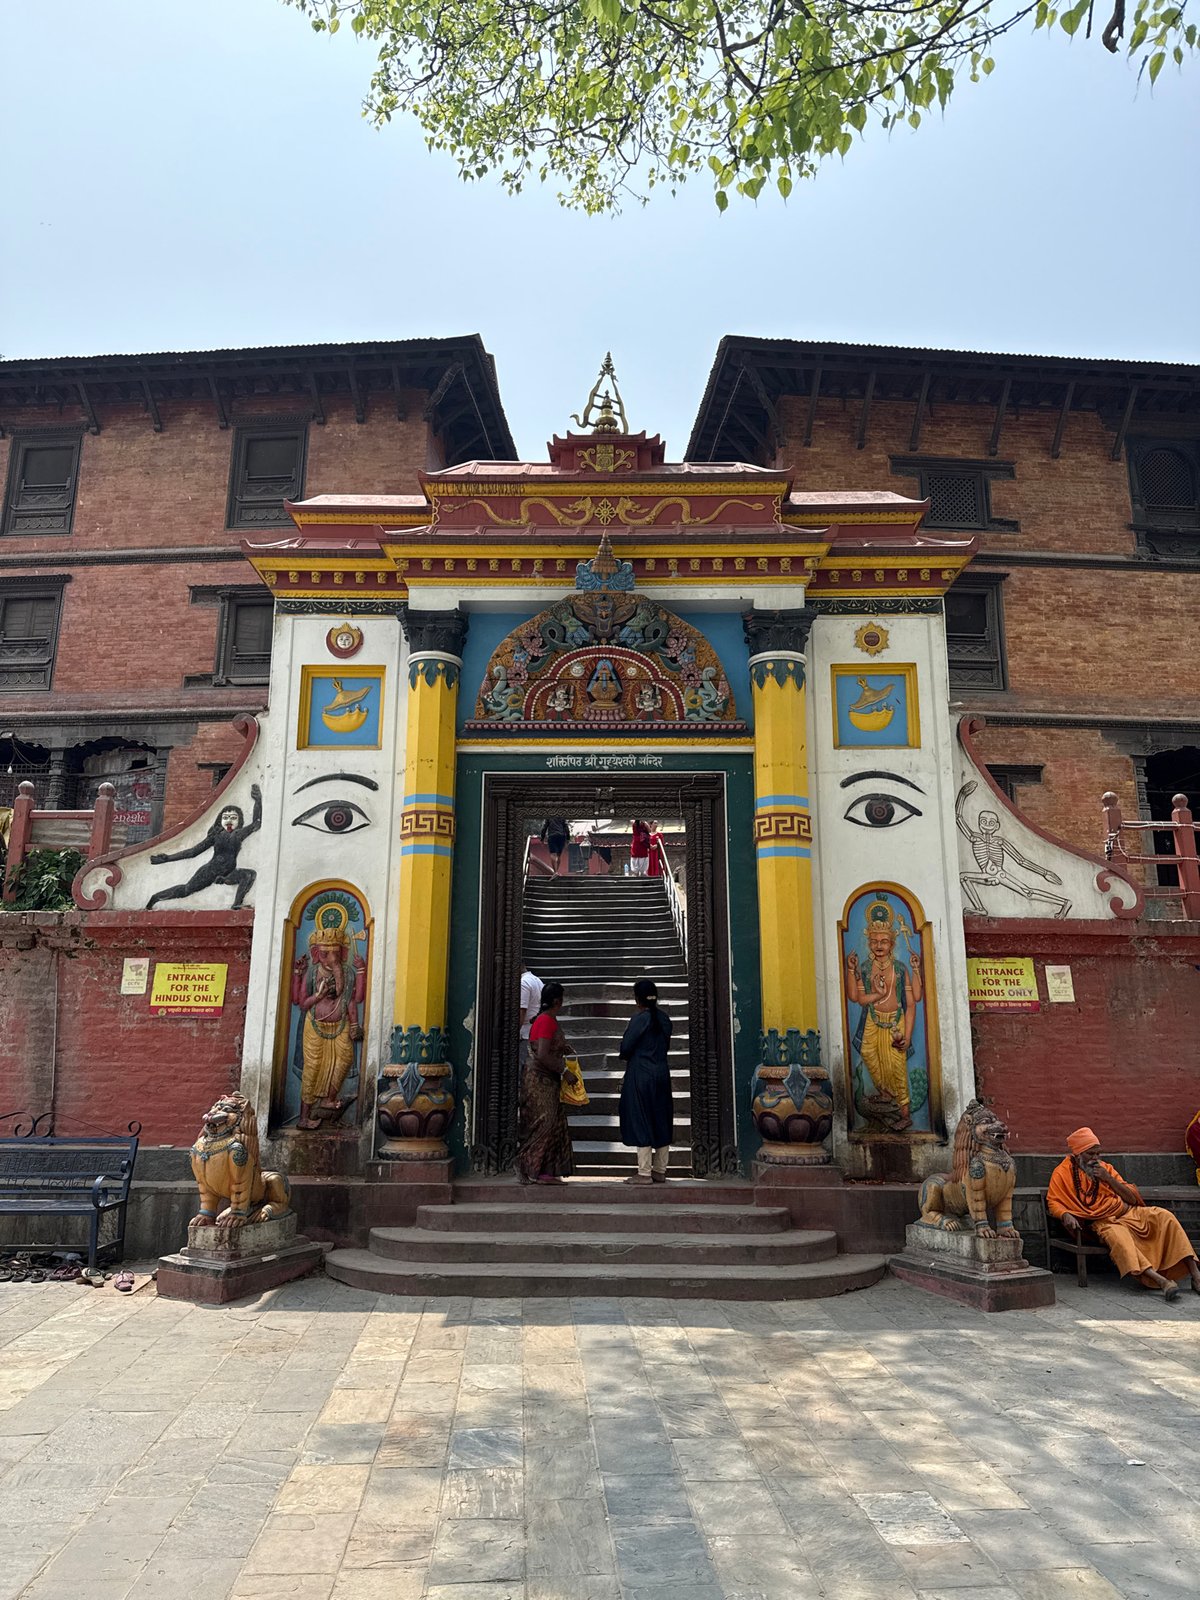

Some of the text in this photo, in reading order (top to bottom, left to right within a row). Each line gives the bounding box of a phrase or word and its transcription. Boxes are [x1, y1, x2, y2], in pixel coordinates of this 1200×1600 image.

[584, 754, 598, 767] श्री
[638, 754, 663, 767] मन्दिर
[976, 968, 1024, 976] ENTRANCE
[166, 973, 216, 982] ENTRANCE
[982, 978, 1021, 986] FOR THE
[170, 984, 210, 992] FOR THE
[969, 989, 1034, 997] HINDUS ONLY
[154, 994, 220, 1002] HINDUS ONLY
